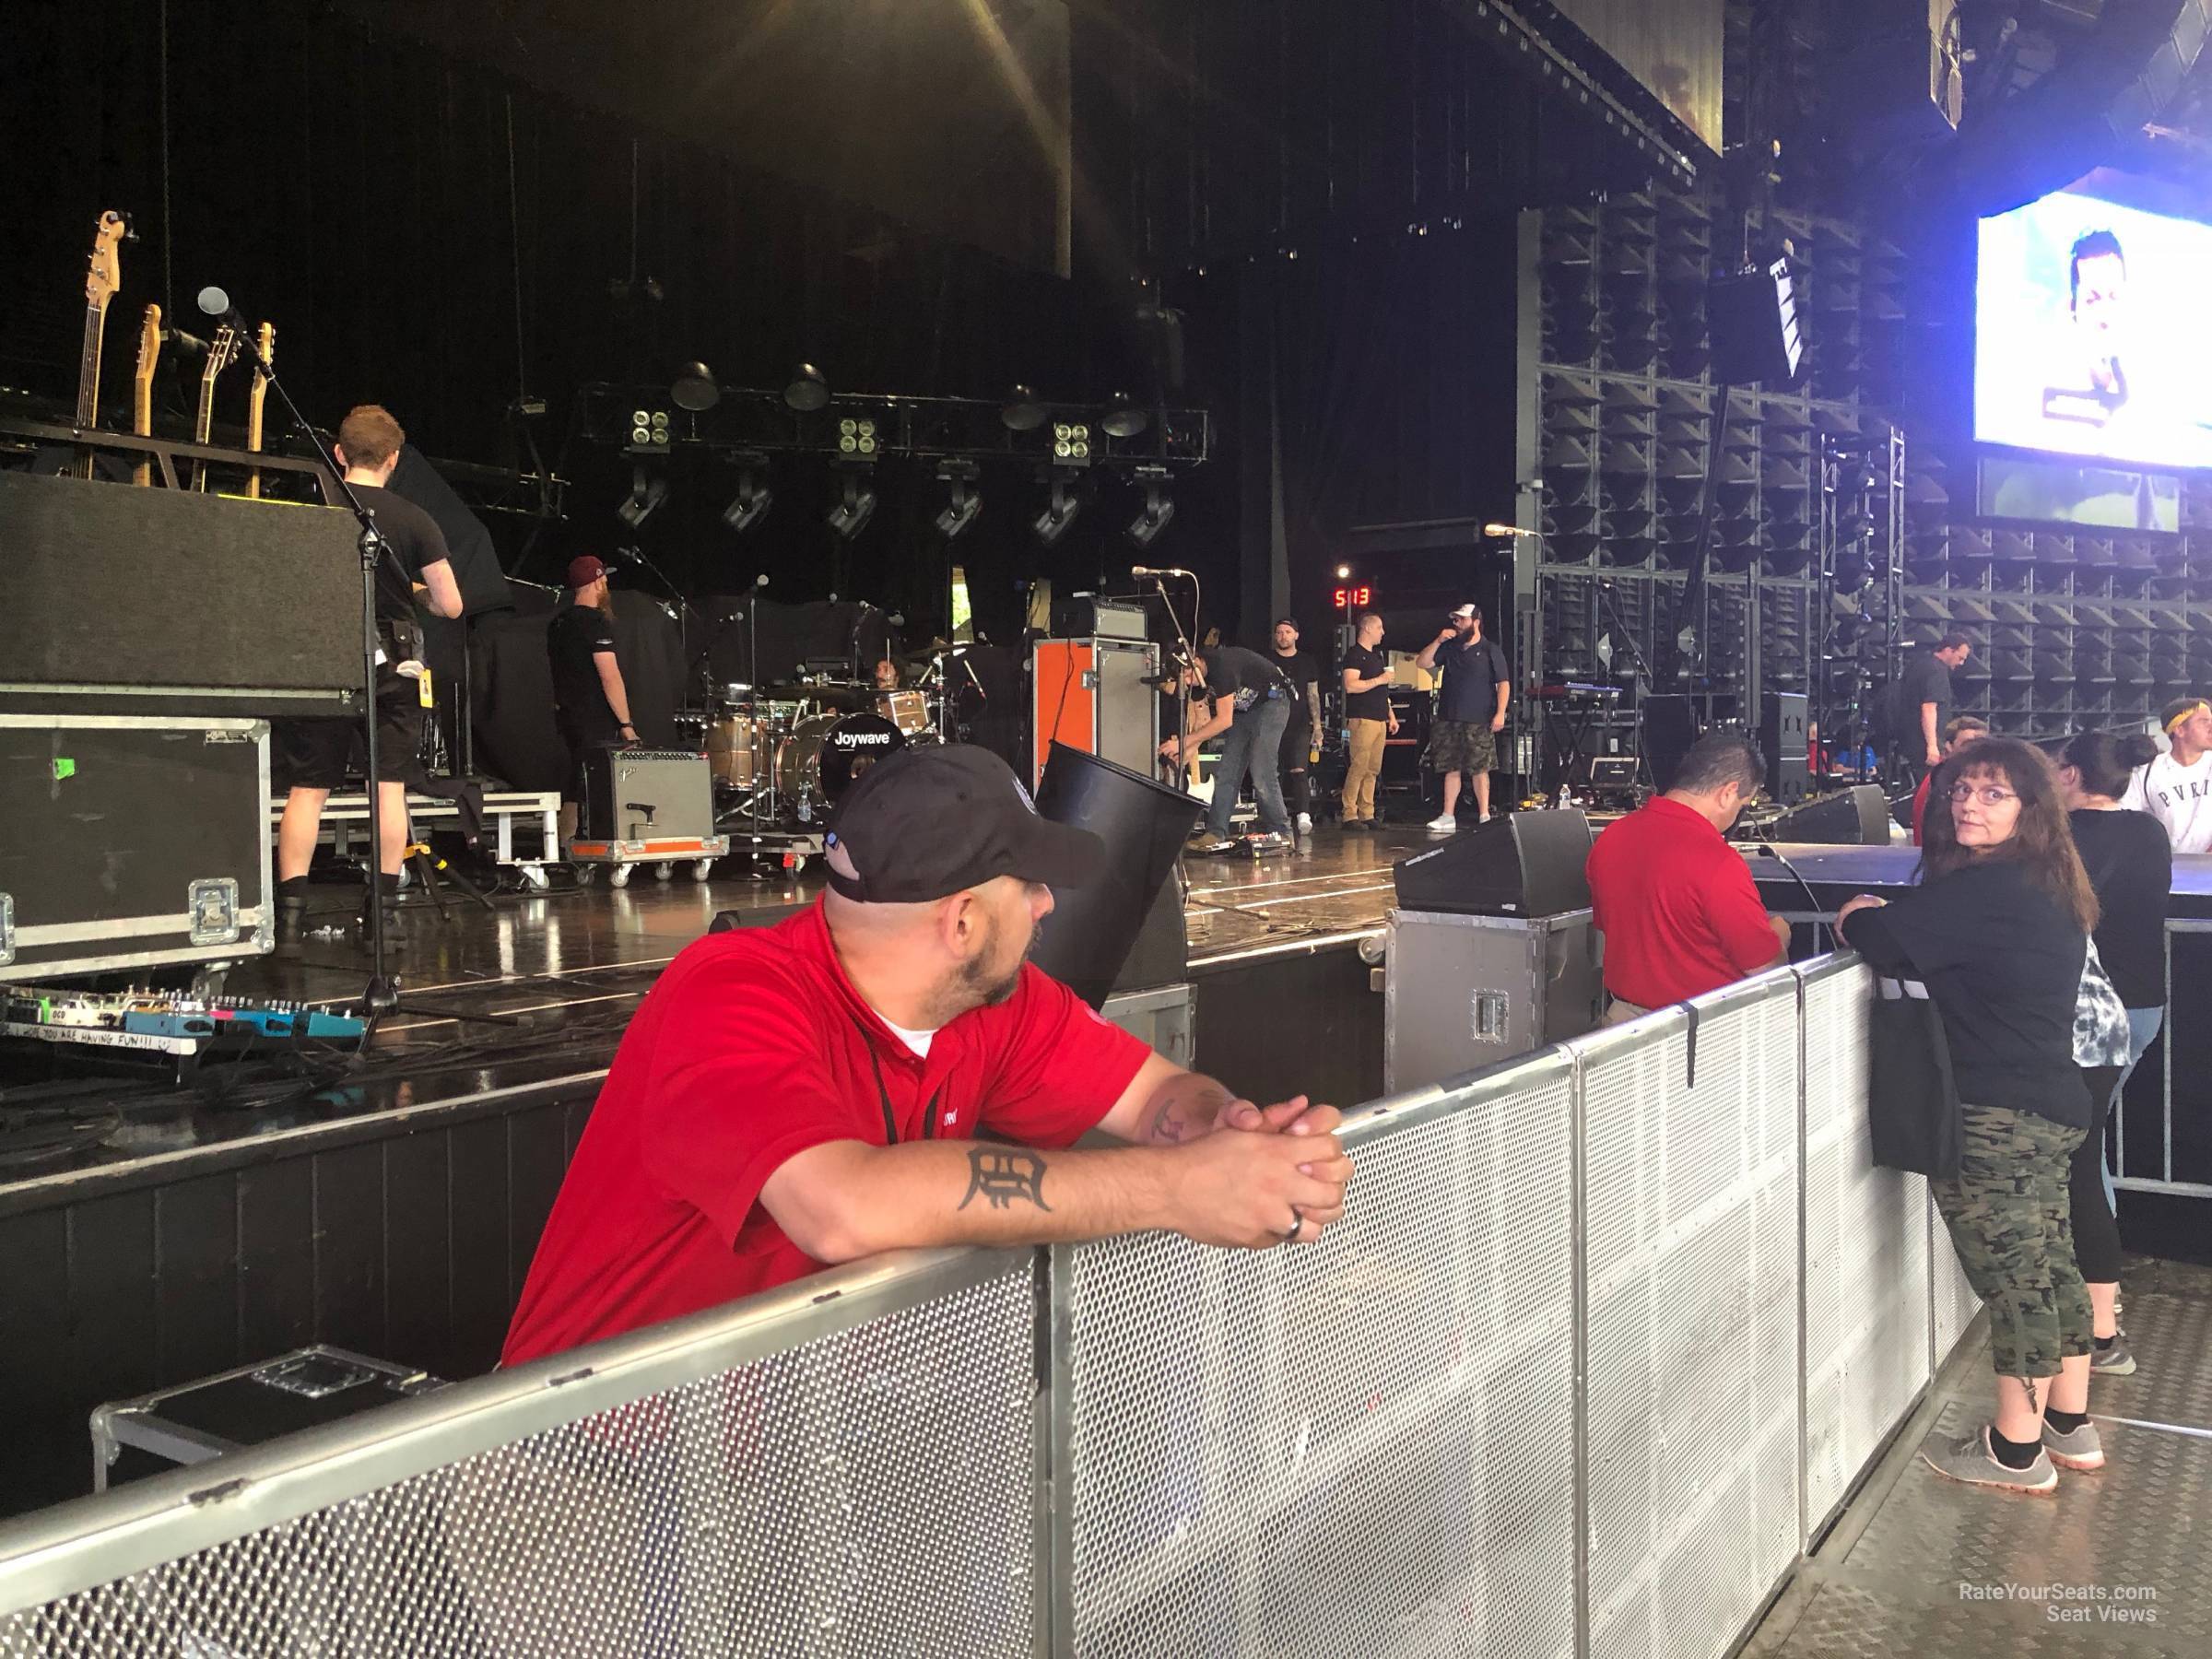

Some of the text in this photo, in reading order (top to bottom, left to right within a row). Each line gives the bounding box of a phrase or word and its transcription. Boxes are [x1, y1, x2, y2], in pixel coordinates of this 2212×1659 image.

[834, 731, 890, 748] Joywave
[61, 1029, 77, 1041] ARE
[81, 1032, 112, 1045] HAVING
[118, 1034, 152, 1049] FUN!!!
